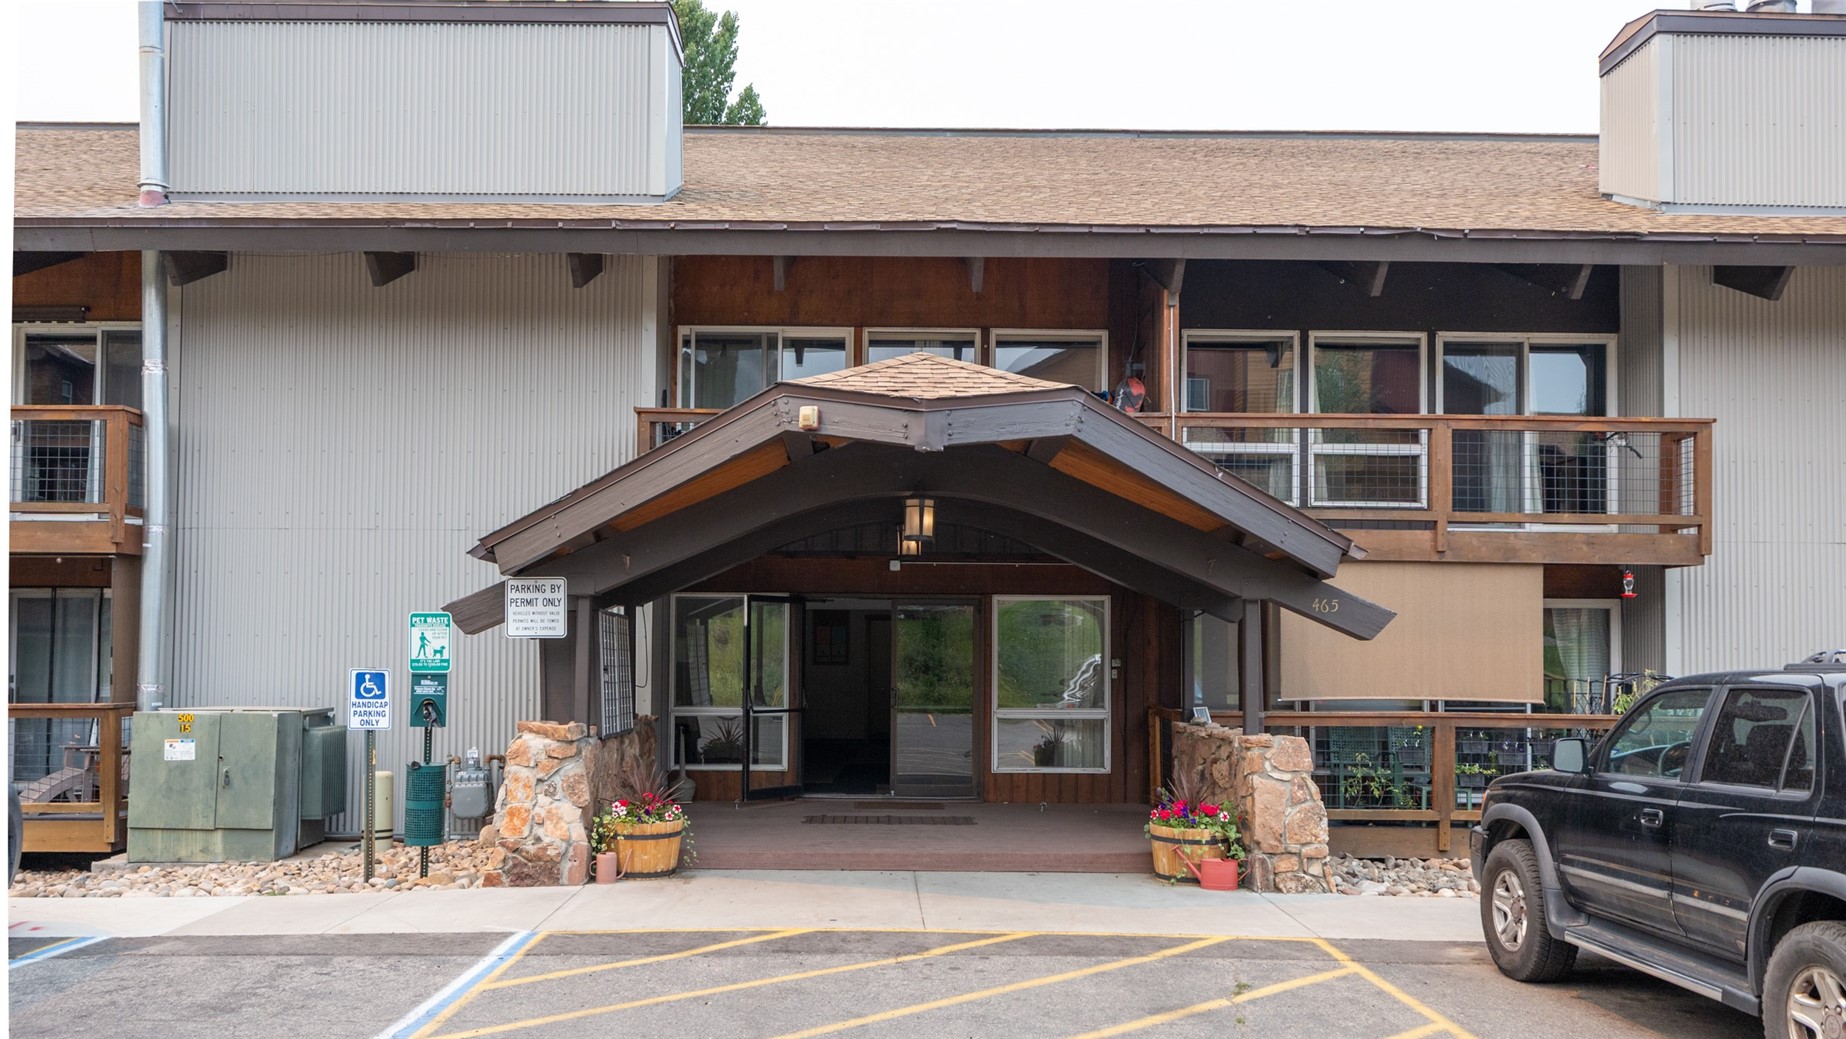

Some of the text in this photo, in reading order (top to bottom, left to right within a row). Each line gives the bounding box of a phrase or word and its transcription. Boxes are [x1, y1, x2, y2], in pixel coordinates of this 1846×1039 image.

[510, 584, 562, 594] PARKING BY
[510, 598, 562, 607] PERMIT ONLY
[1312, 598, 1339, 613] 465
[178, 714, 195, 723] 500
[180, 724, 191, 733] 15
